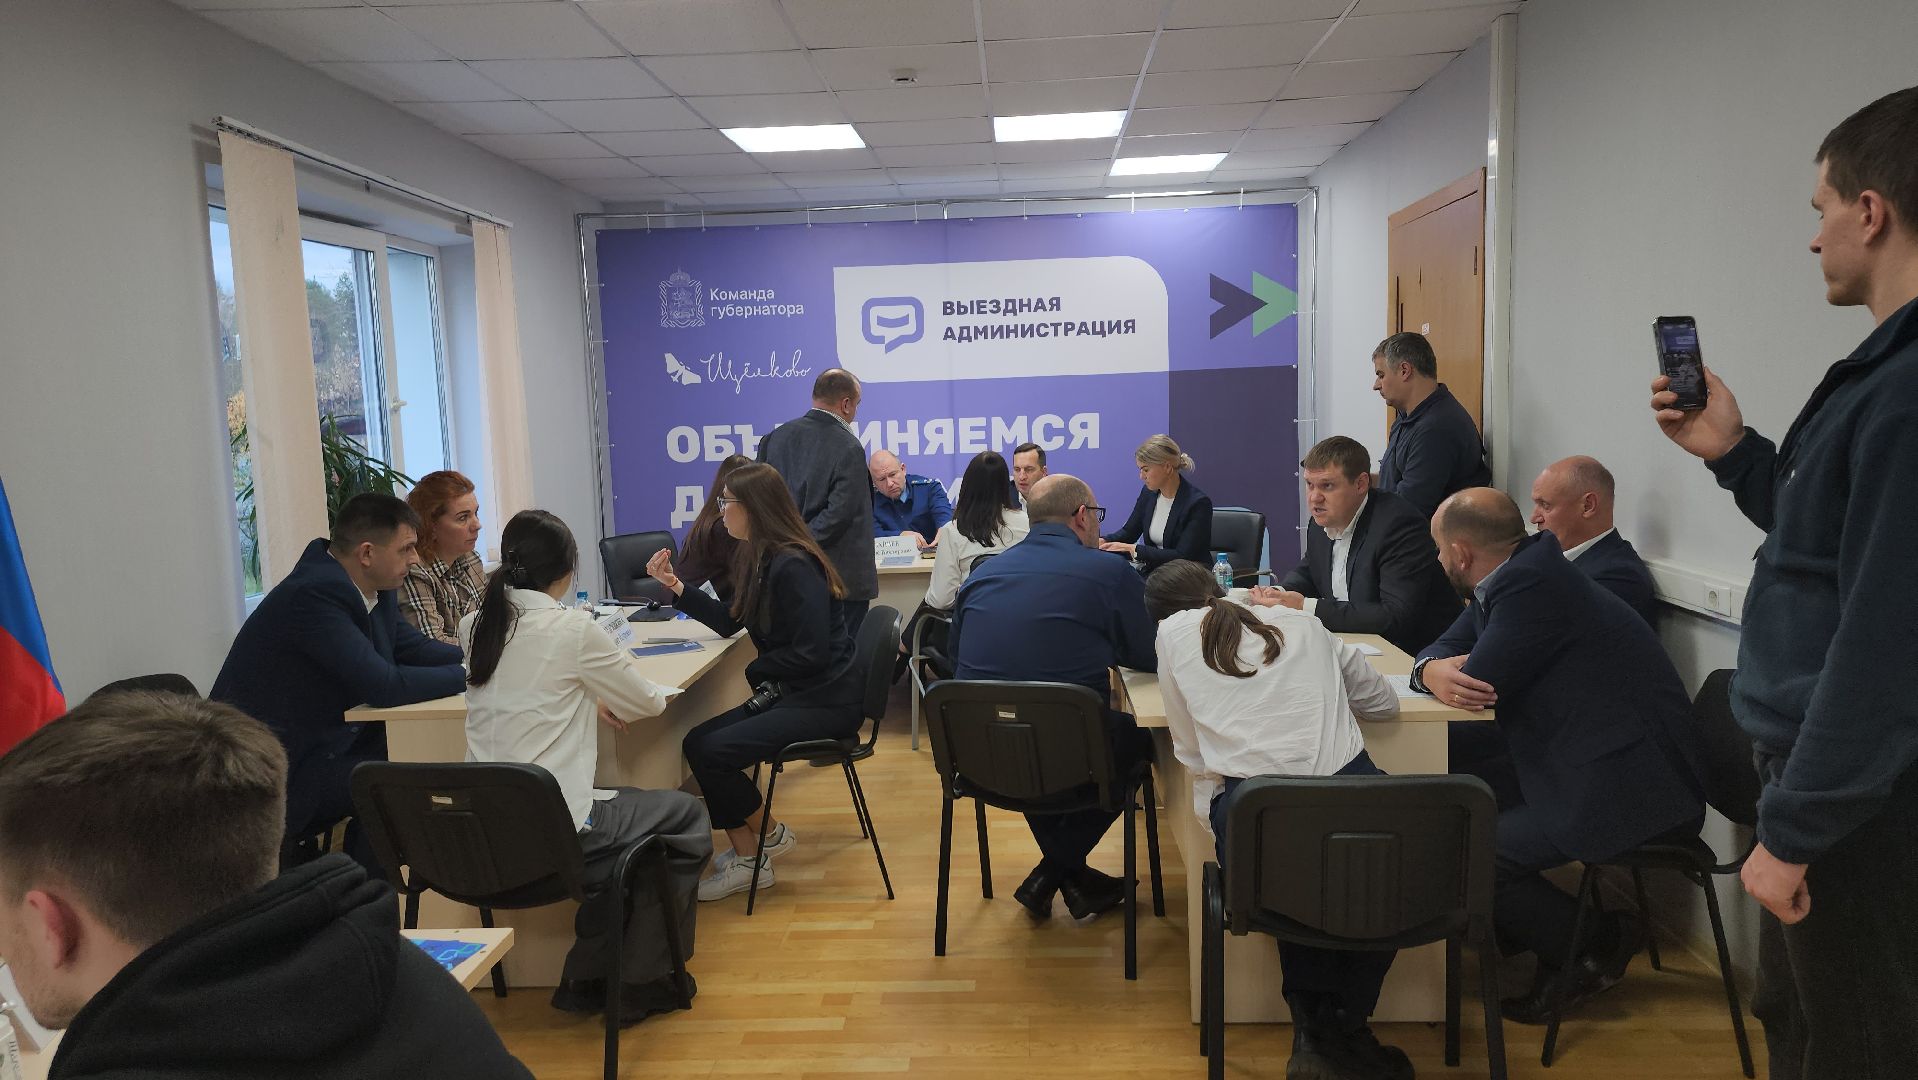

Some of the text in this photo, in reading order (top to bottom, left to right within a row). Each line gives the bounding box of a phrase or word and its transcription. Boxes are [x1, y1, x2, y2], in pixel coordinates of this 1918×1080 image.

[709, 287, 775, 302] Команда
[711, 303, 805, 320] губернатора
[942, 296, 1061, 317] ВЫЕЗДНАЯ
[942, 318, 1137, 344] АДМИНИСТРАЦИЯ
[666, 412, 1100, 464] ОБЪИНЯЕМСЯ
